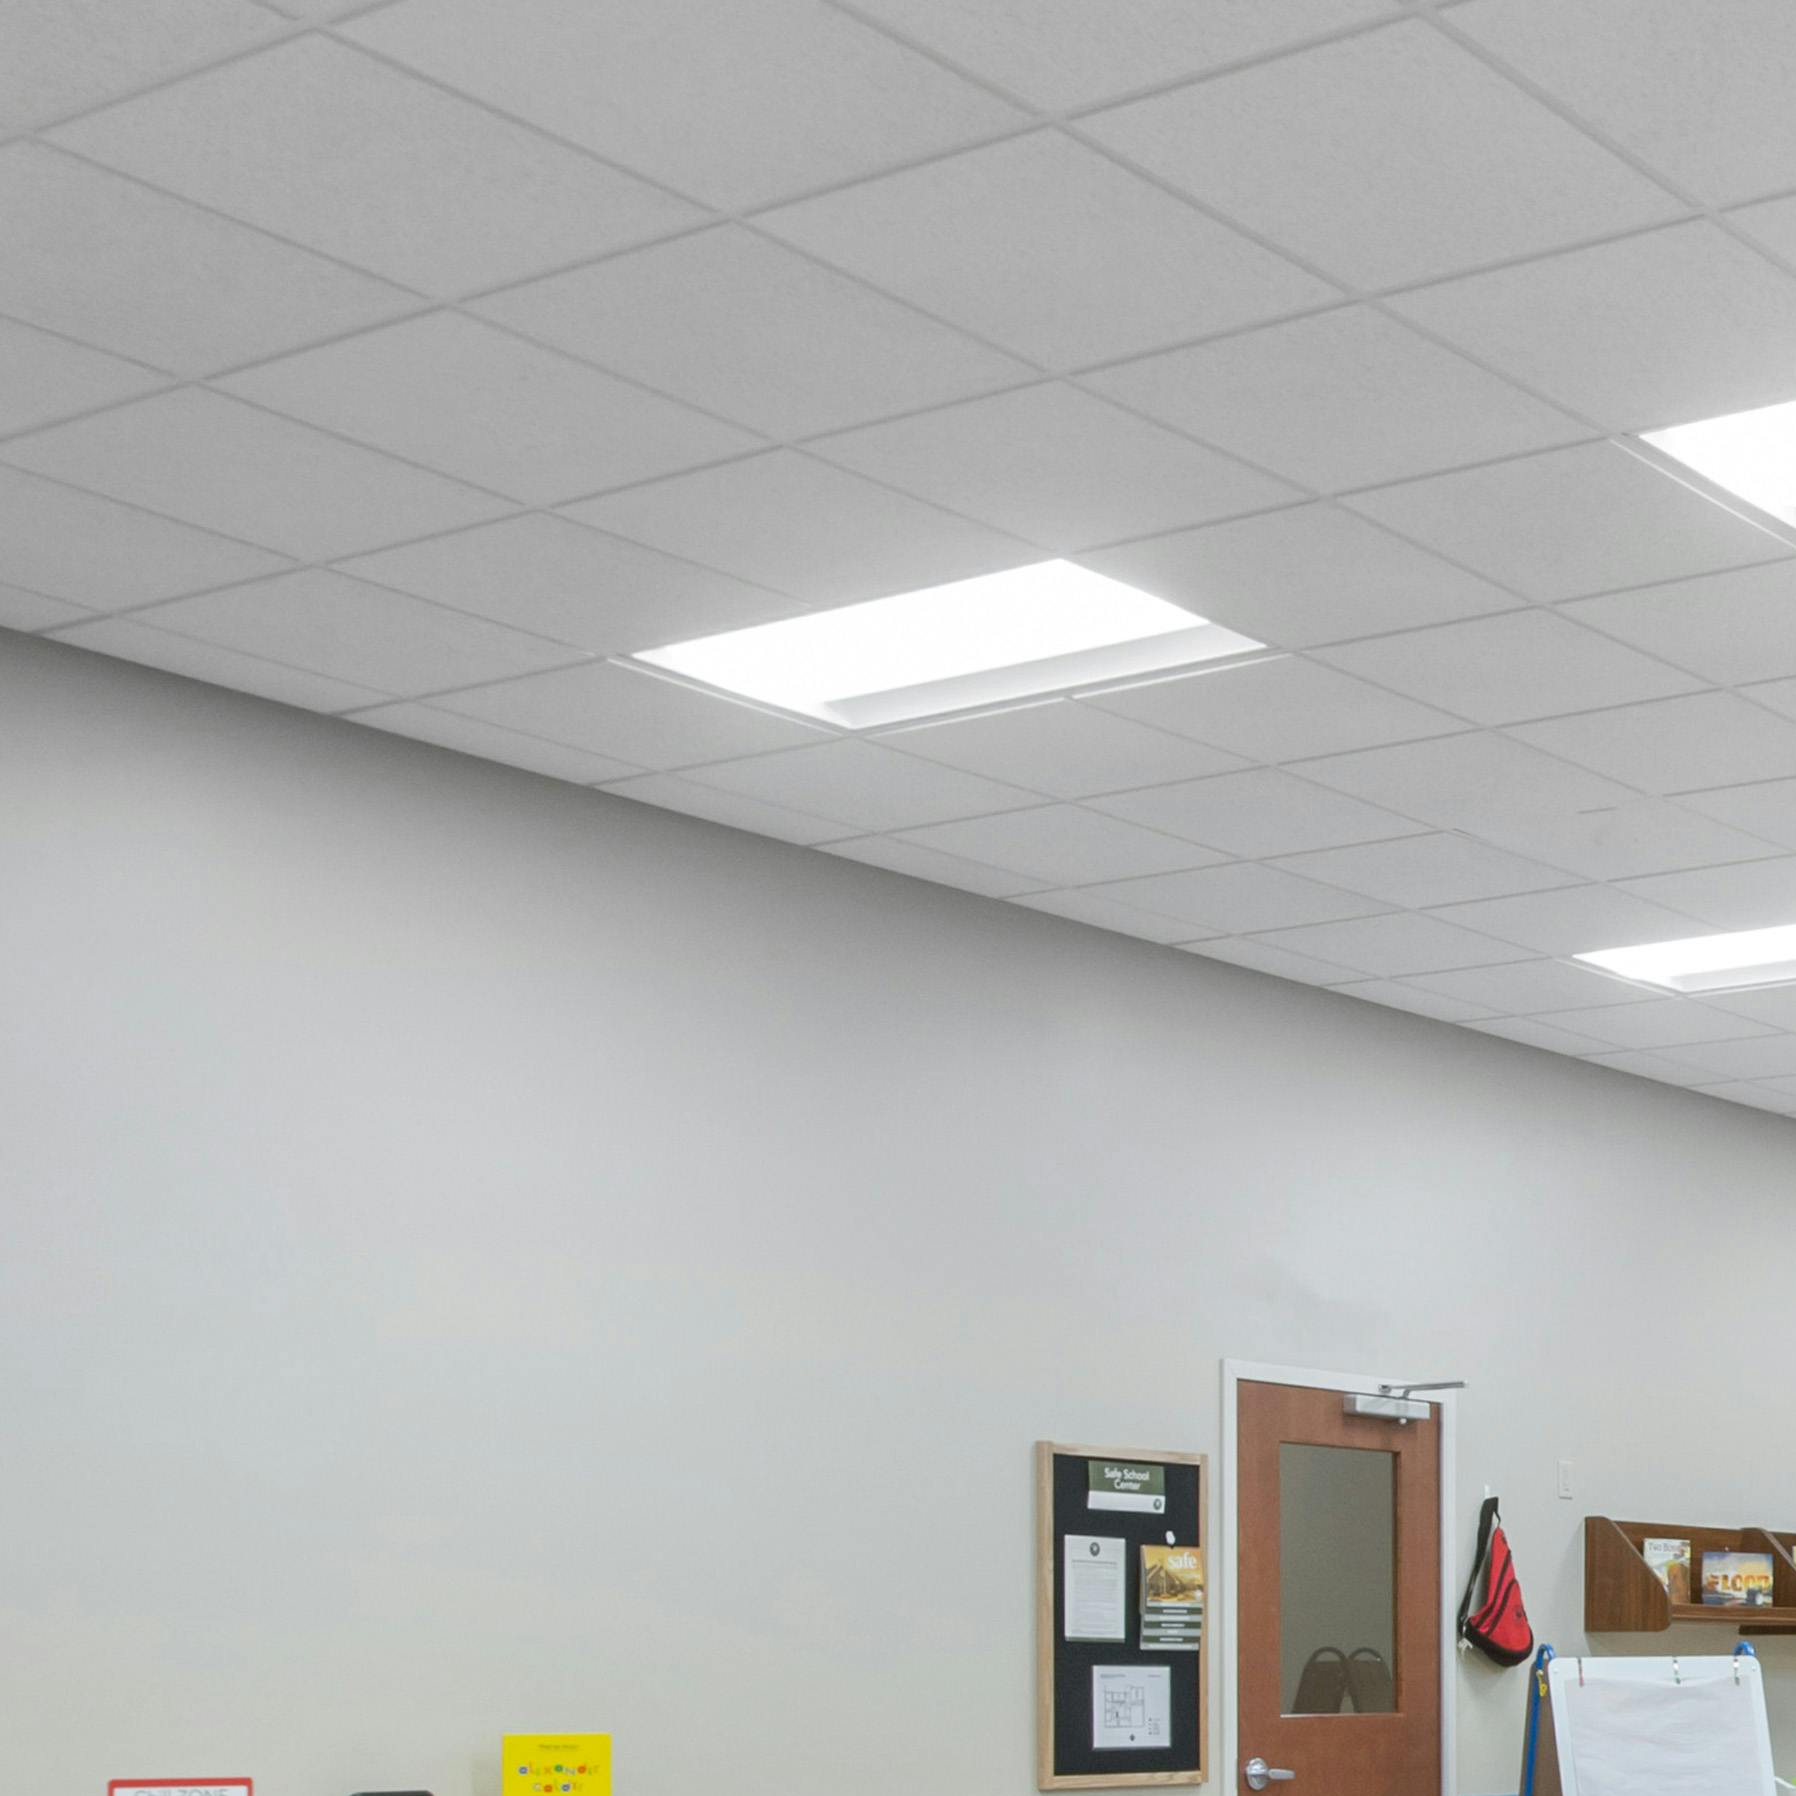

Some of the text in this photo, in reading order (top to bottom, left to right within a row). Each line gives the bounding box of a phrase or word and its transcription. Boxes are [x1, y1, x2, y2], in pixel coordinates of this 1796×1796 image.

[1104, 1467, 1150, 1481] Safe School
[1113, 1478, 1141, 1491] Center
[1167, 1552, 1197, 1569] safe
